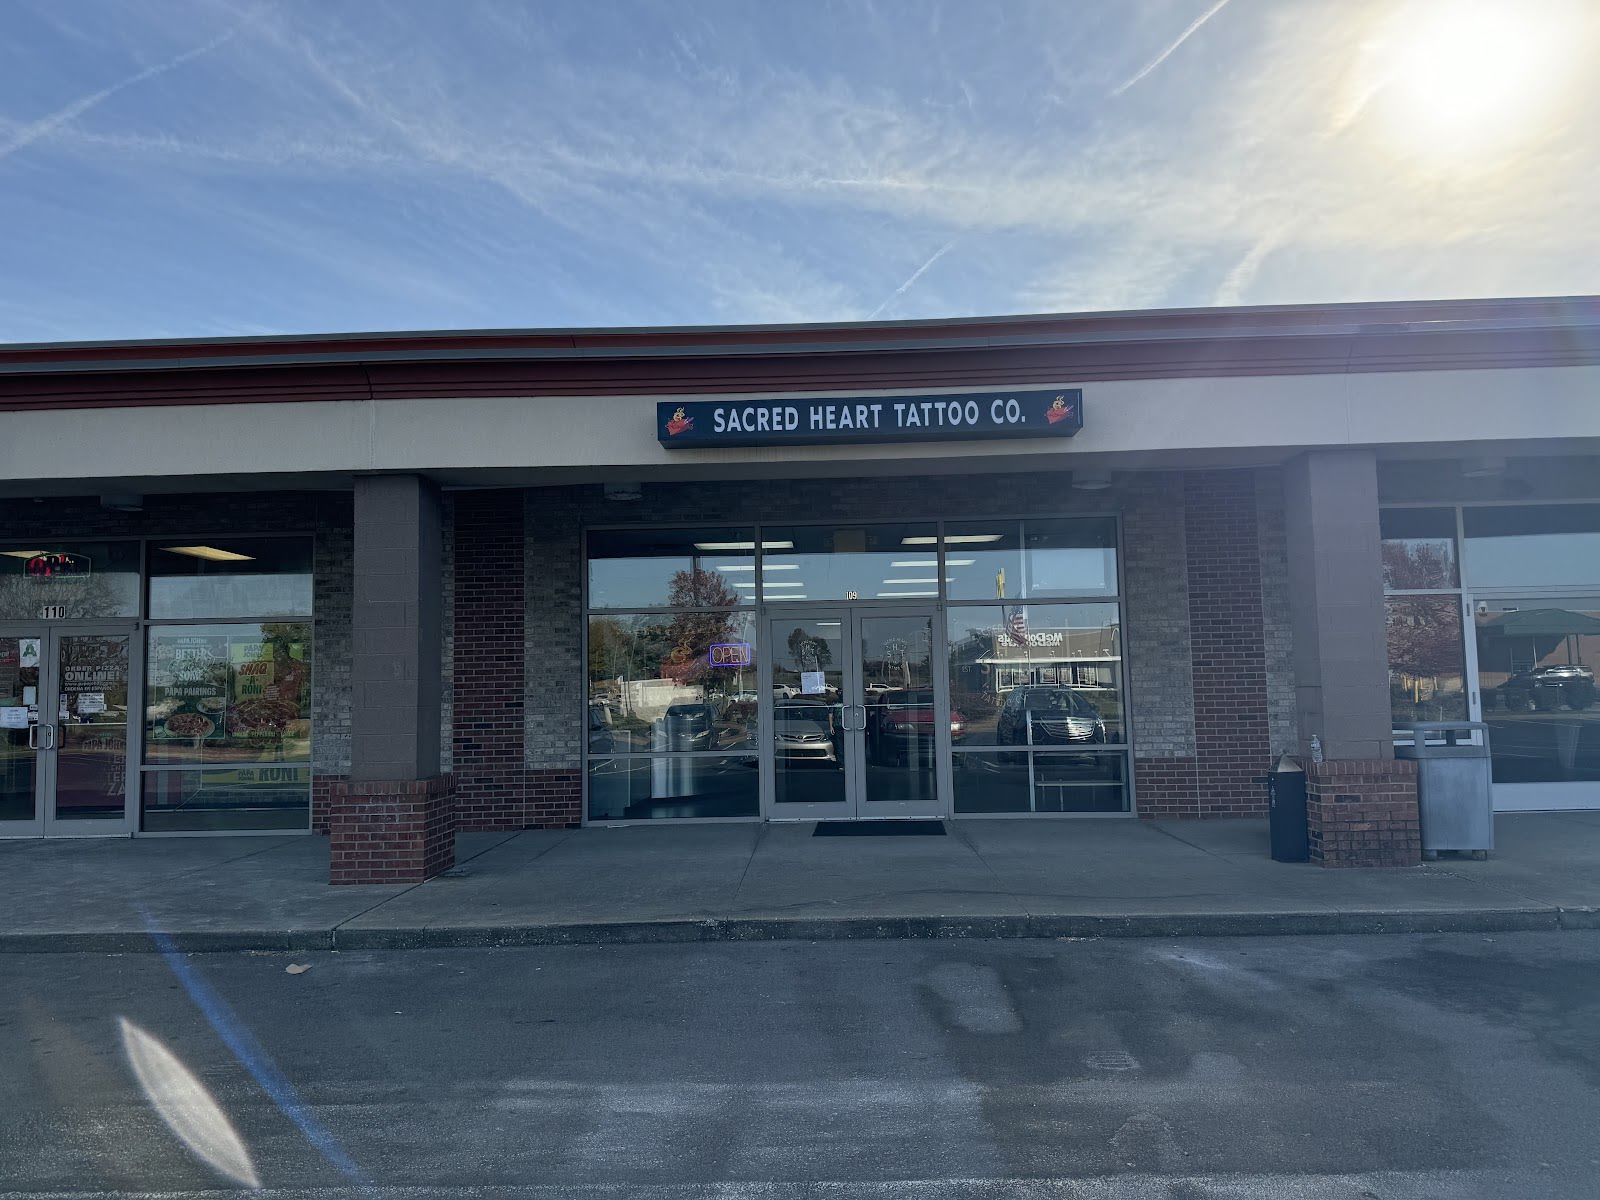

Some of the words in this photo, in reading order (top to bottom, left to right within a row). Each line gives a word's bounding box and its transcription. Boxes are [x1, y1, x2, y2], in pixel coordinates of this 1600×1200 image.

[713, 407, 799, 432] SACRED
[809, 404, 882, 430] HEART
[893, 400, 980, 427] TATTOO
[990, 399, 1025, 424] CO.
[846, 591, 857, 600] 109
[44, 606, 65, 618] 110
[712, 646, 748, 664] OPEN
[239, 662, 267, 676] SHAQ
[65, 671, 120, 680] ONLINE!
[164, 687, 183, 696] PAPA
[242, 684, 262, 694] RONI
